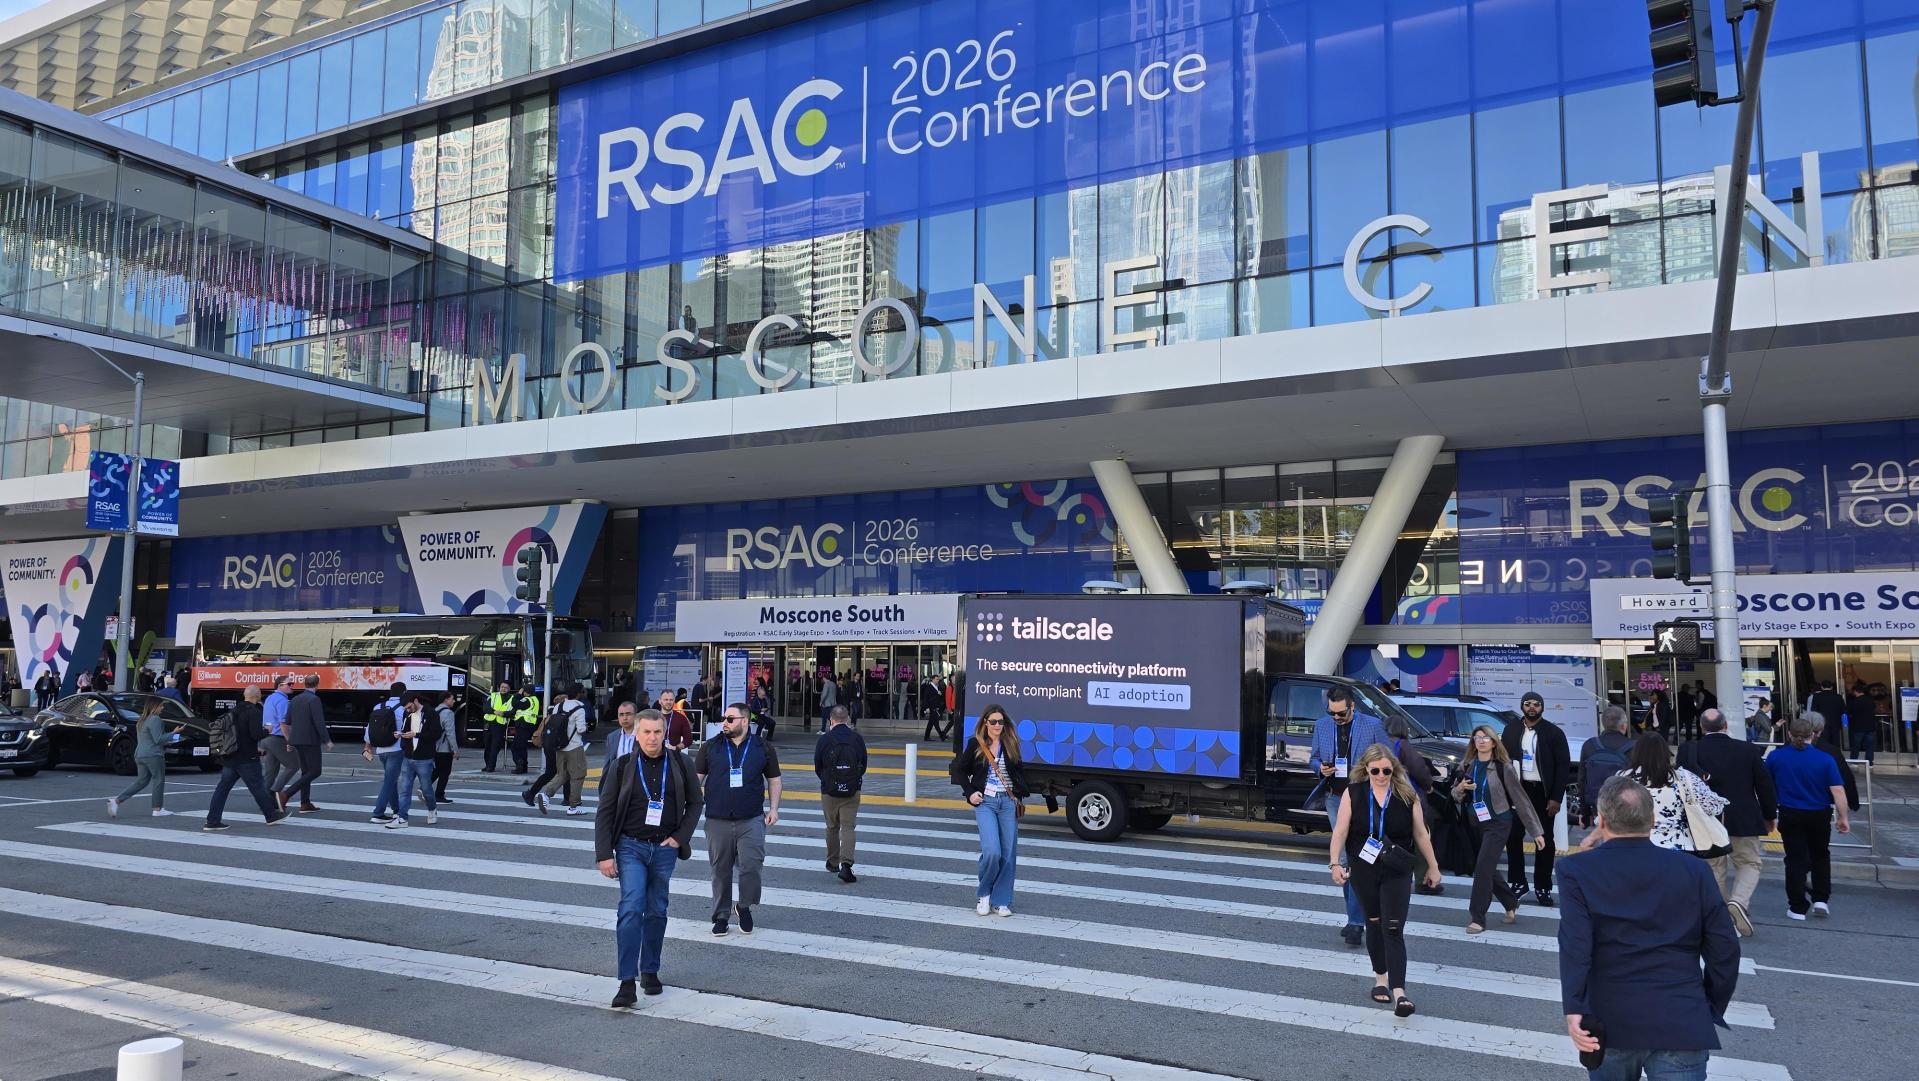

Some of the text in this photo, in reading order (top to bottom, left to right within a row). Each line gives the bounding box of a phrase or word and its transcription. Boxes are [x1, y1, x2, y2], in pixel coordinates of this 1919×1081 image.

[890, 30, 1017, 106] 2026
[887, 51, 1207, 156] Conference
[596, 79, 844, 219] RSAC
[471, 255, 1163, 425] MOSCONE
[95, 501, 121, 511] RSAC
[1848, 496, 1919, 528] Co
[420, 531, 481, 546] POWER OF
[864, 518, 919, 542] 2026
[419, 546, 496, 562] COMMUNITY.
[726, 523, 845, 571] RSAC
[863, 543, 993, 566] Conference
[9, 557, 47, 569] POWER OF
[308, 550, 342, 569] 2026
[8, 569, 56, 581] COMMUNITY.
[223, 553, 297, 590] RSAC
[306, 568, 384, 588] Conference
[1632, 597, 1697, 607] Howard
[1736, 592, 1865, 612] oscone
[760, 603, 905, 624] Moscone South
[850, 629, 865, 637] Expo
[923, 628, 948, 636] Villages
[1011, 616, 1113, 641] tailscale
[1619, 620, 1916, 633] Regist RS arly Stage Expo South Expo
[235, 672, 269, 683] Contain
[975, 658, 1187, 679] The secure connectivity platform
[1640, 673, 1662, 682] Exit
[975, 682, 1184, 704] for fast, compliant AI adoption
[1638, 681, 1666, 691] Only
